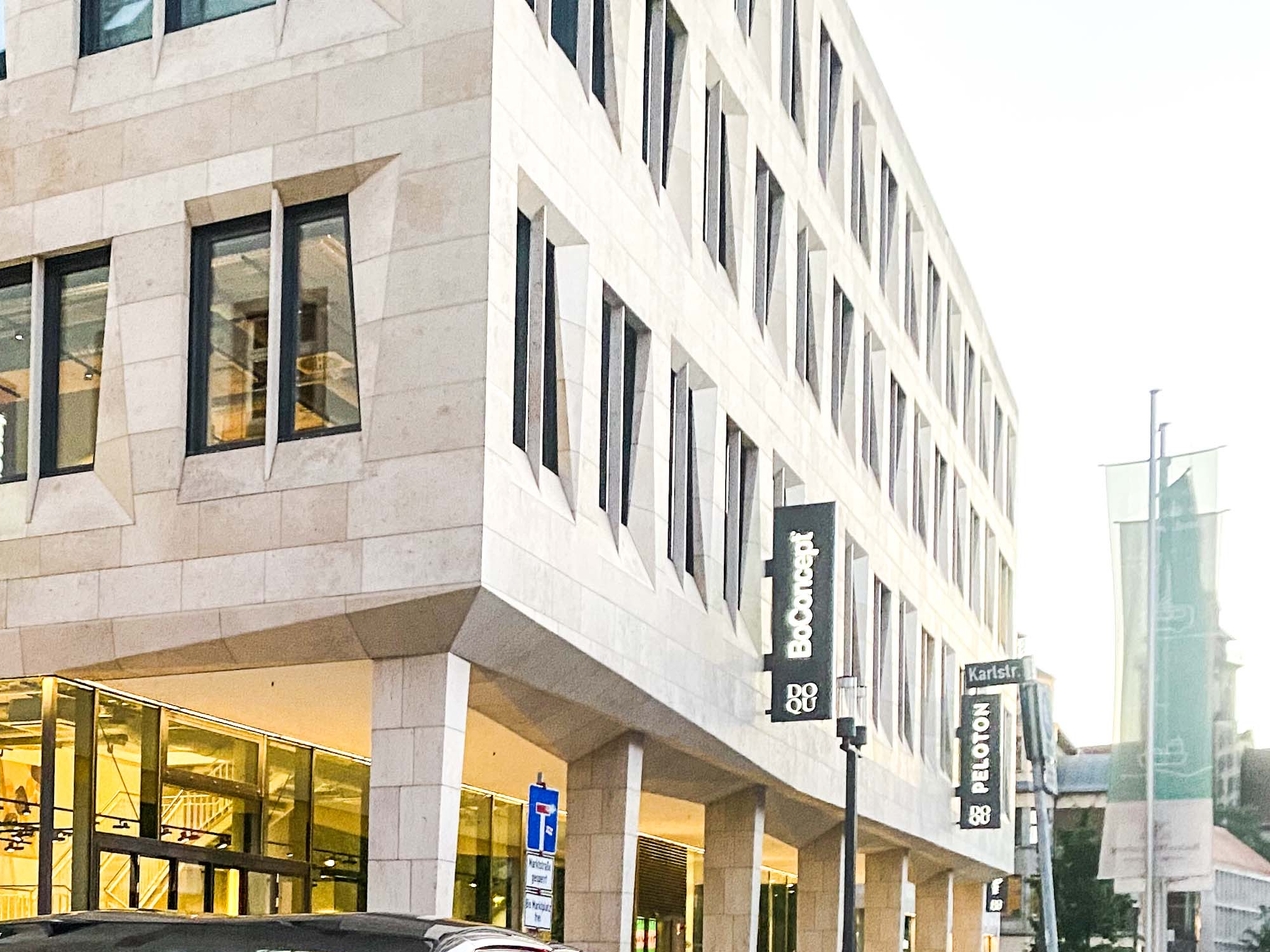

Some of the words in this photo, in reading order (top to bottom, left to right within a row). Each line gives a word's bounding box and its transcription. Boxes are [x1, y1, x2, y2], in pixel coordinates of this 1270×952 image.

[787, 530, 820, 659] BoConcept
[968, 664, 1022, 682] Karlstr.
[786, 682, 818, 699] DO
[785, 697, 818, 715] QU
[970, 702, 991, 794] PELOTON
